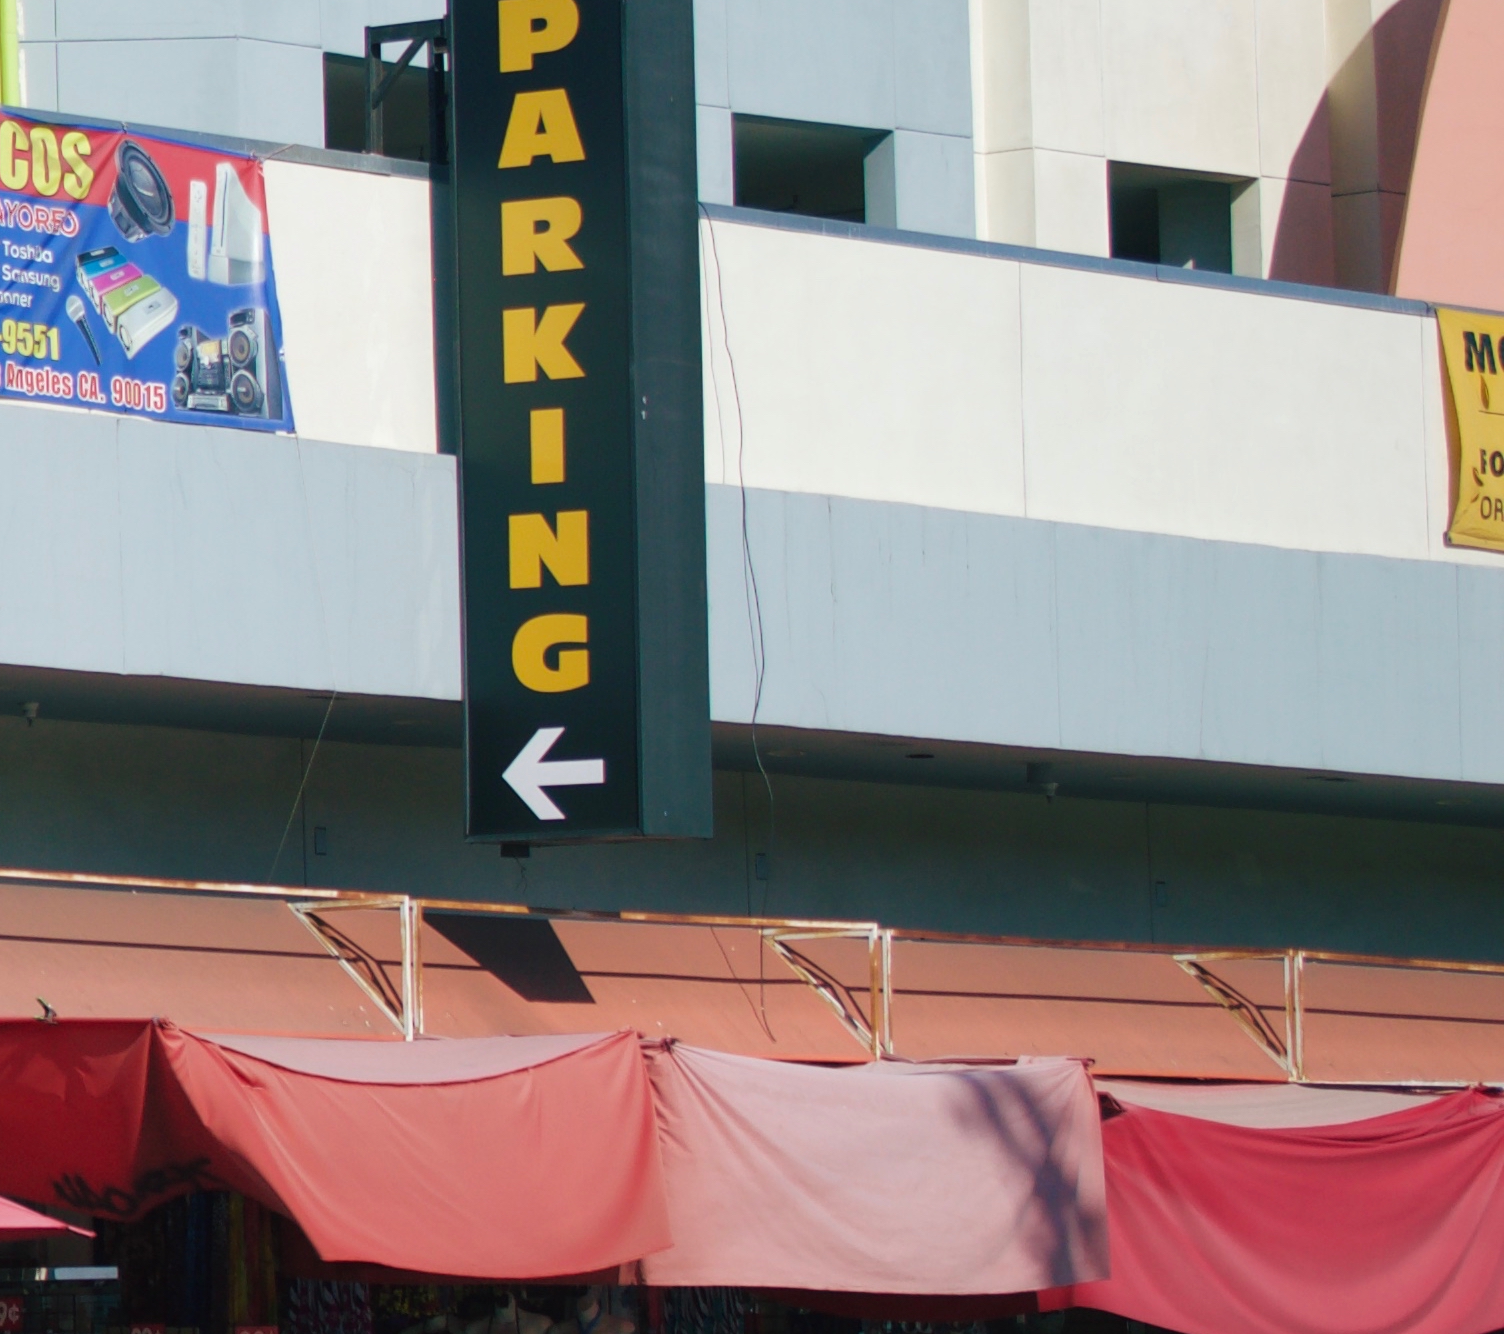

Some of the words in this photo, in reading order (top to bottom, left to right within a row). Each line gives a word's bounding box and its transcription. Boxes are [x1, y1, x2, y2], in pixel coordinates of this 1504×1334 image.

[5, 364, 71, 400] Angeles
[77, 374, 105, 404] CA.
[111, 381, 167, 414] 90015
